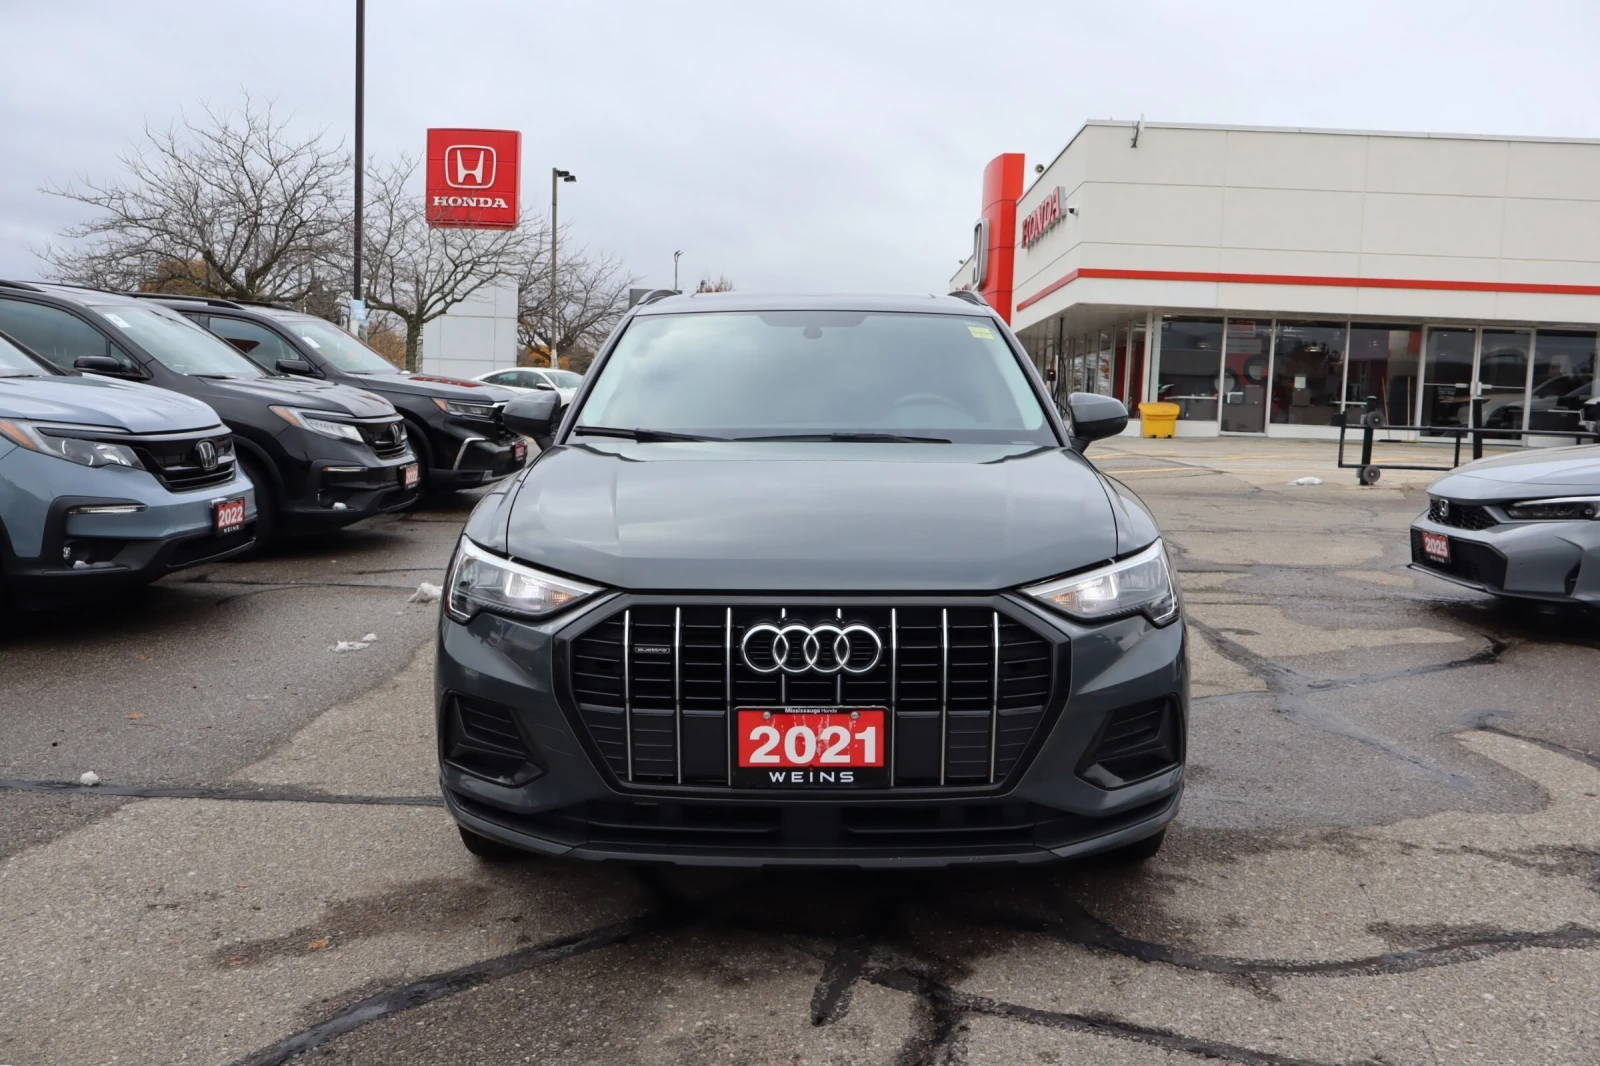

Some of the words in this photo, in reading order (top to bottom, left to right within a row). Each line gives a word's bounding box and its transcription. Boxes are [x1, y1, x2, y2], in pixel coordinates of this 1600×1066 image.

[432, 196, 509, 209] HONDA
[1021, 186, 1061, 249] HONDA
[218, 505, 244, 528] 2022
[1425, 537, 1448, 557] 2025
[784, 707, 821, 715] Mississauga
[749, 725, 876, 764] 2021
[769, 771, 855, 783] WEINS
